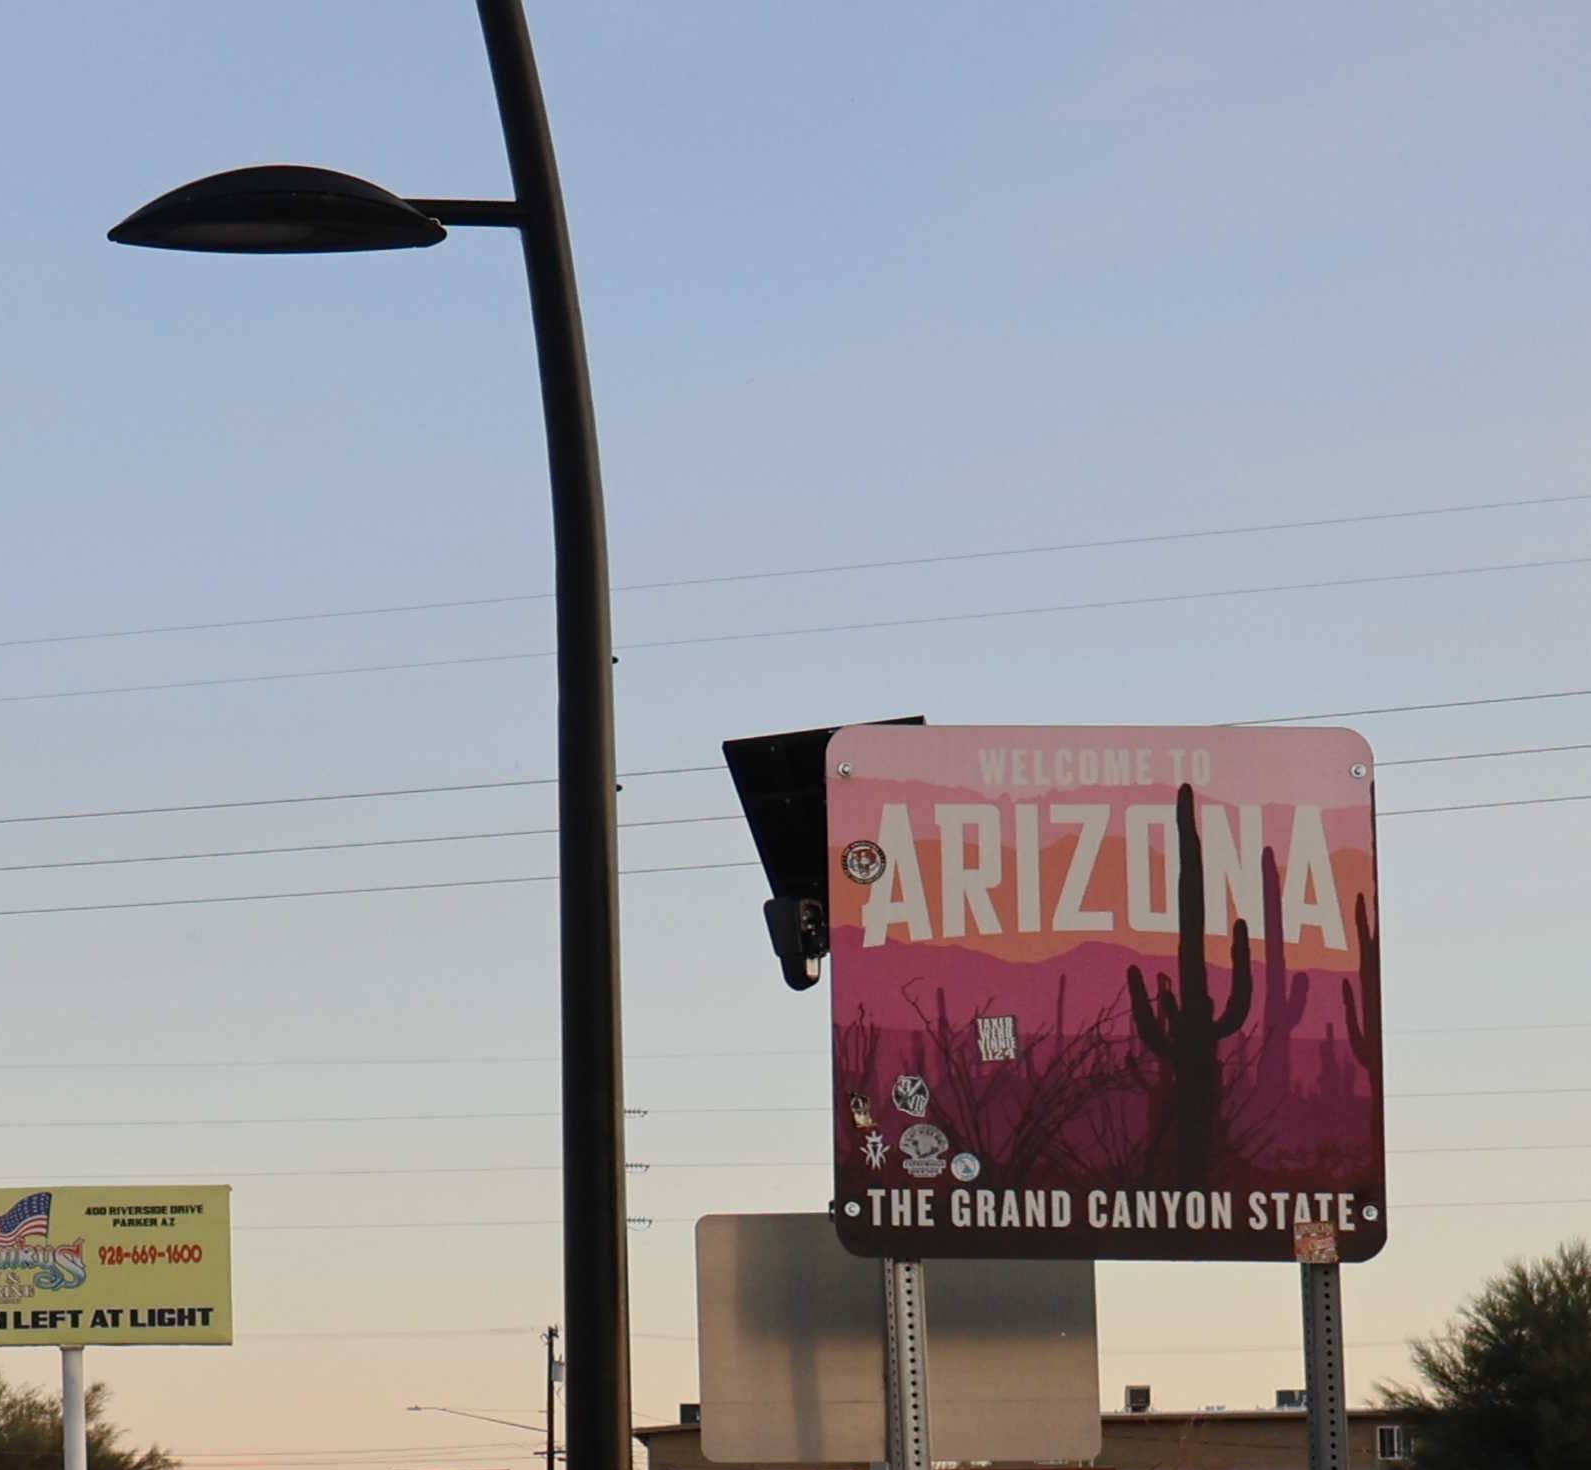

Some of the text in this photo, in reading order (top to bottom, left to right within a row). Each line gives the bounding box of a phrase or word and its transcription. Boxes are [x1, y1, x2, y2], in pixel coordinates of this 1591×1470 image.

[978, 747, 1212, 786] WELCOME TO
[861, 801, 1349, 953] ARIZONA
[109, 1205, 168, 1215] RIVERSIDE
[170, 1204, 204, 1214] DRIVE
[867, 1188, 1356, 1232] THE GRAND CANYON STATE
[112, 1218, 158, 1228] PARKER
[98, 1244, 203, 1265] 928-669-1600
[13, 1309, 83, 1330] LEFT
[90, 1309, 124, 1328] AT
[129, 1307, 214, 1328] LIGHT
